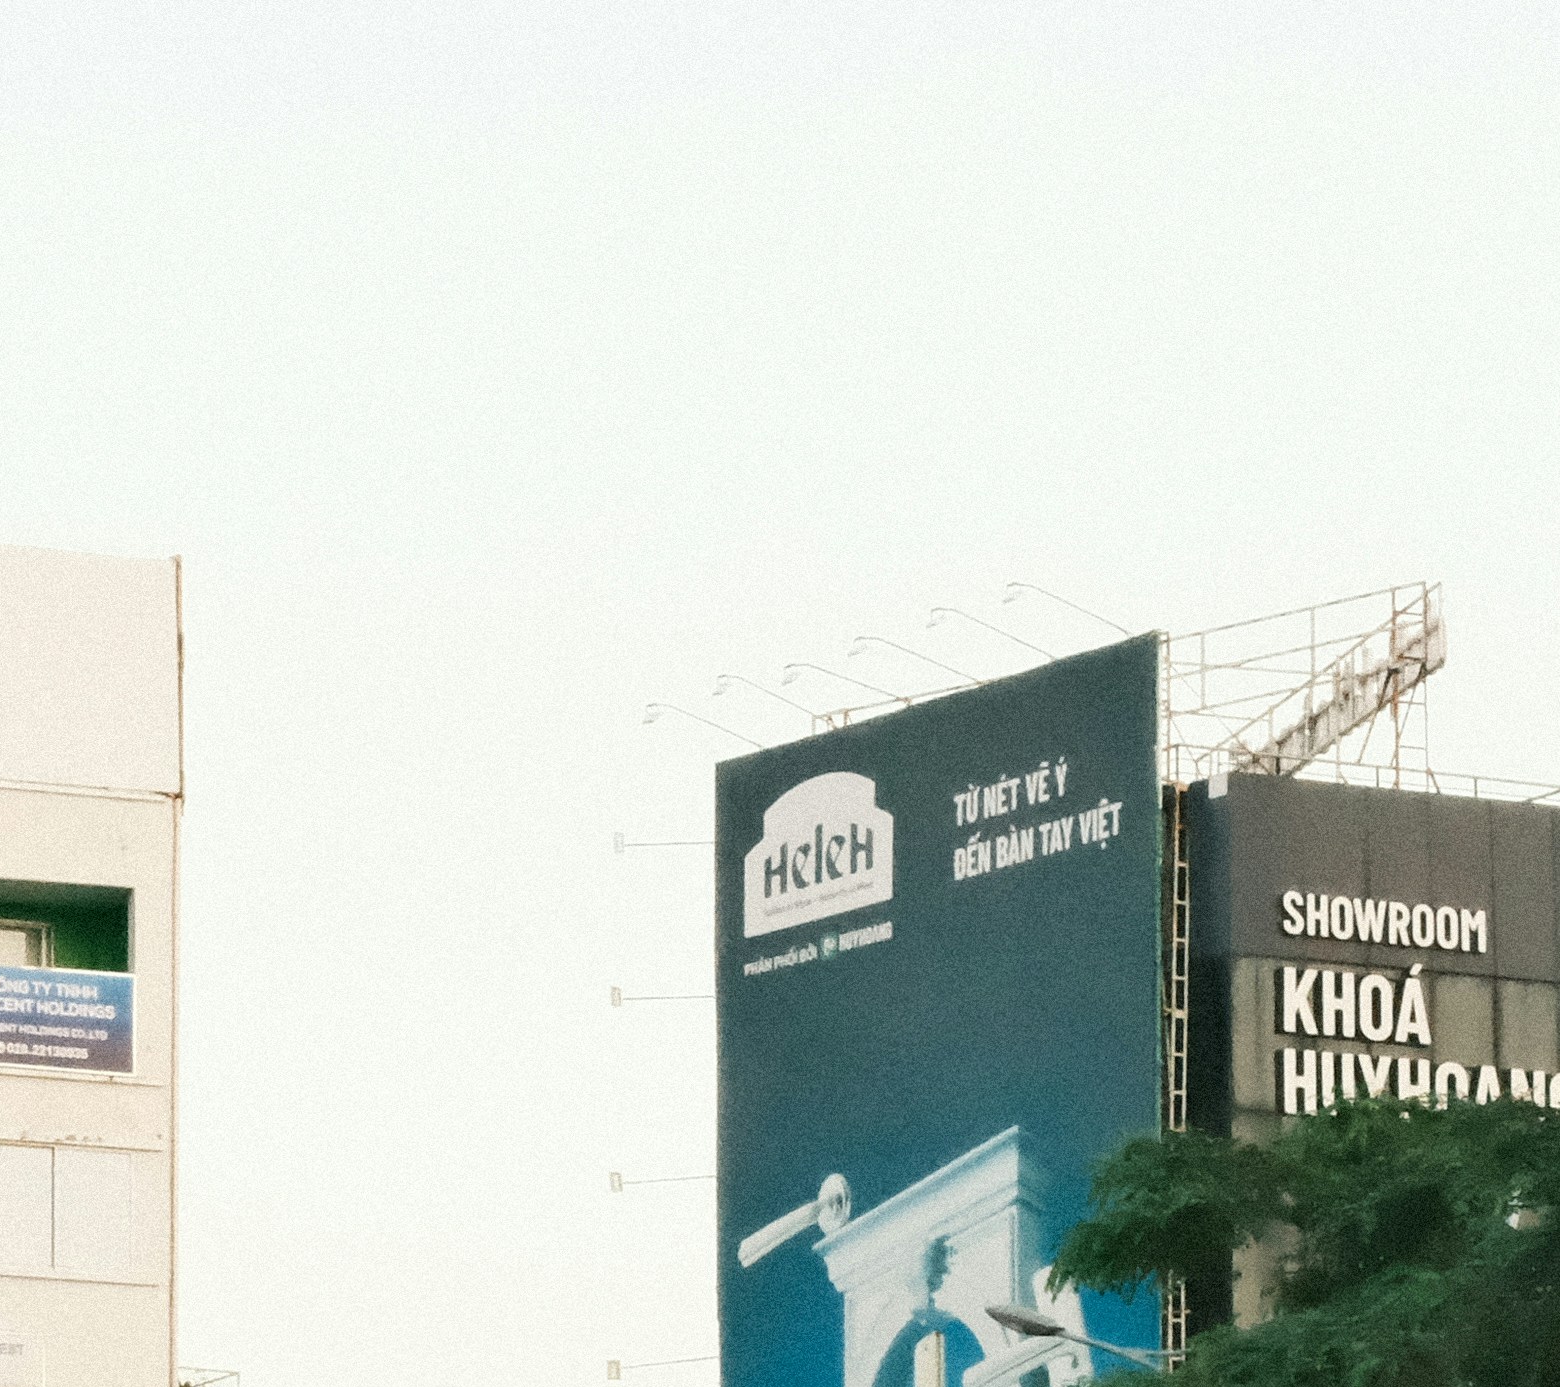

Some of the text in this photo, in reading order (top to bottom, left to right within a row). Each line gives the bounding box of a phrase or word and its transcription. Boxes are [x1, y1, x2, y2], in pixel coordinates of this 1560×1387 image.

[954, 784, 979, 827] TỪ
[983, 774, 1020, 819] NÉT
[1054, 756, 1068, 798] Ý
[995, 824, 1034, 867] BÀN
[1039, 816, 1075, 857] TAY
[1079, 798, 1123, 851] VIỆT
[1282, 890, 1488, 953] SHOWROOM
[33, 980, 52, 996] TY
[37, 1000, 116, 1020] HOLDINGS
[1283, 963, 1432, 1045] KHOÁ
